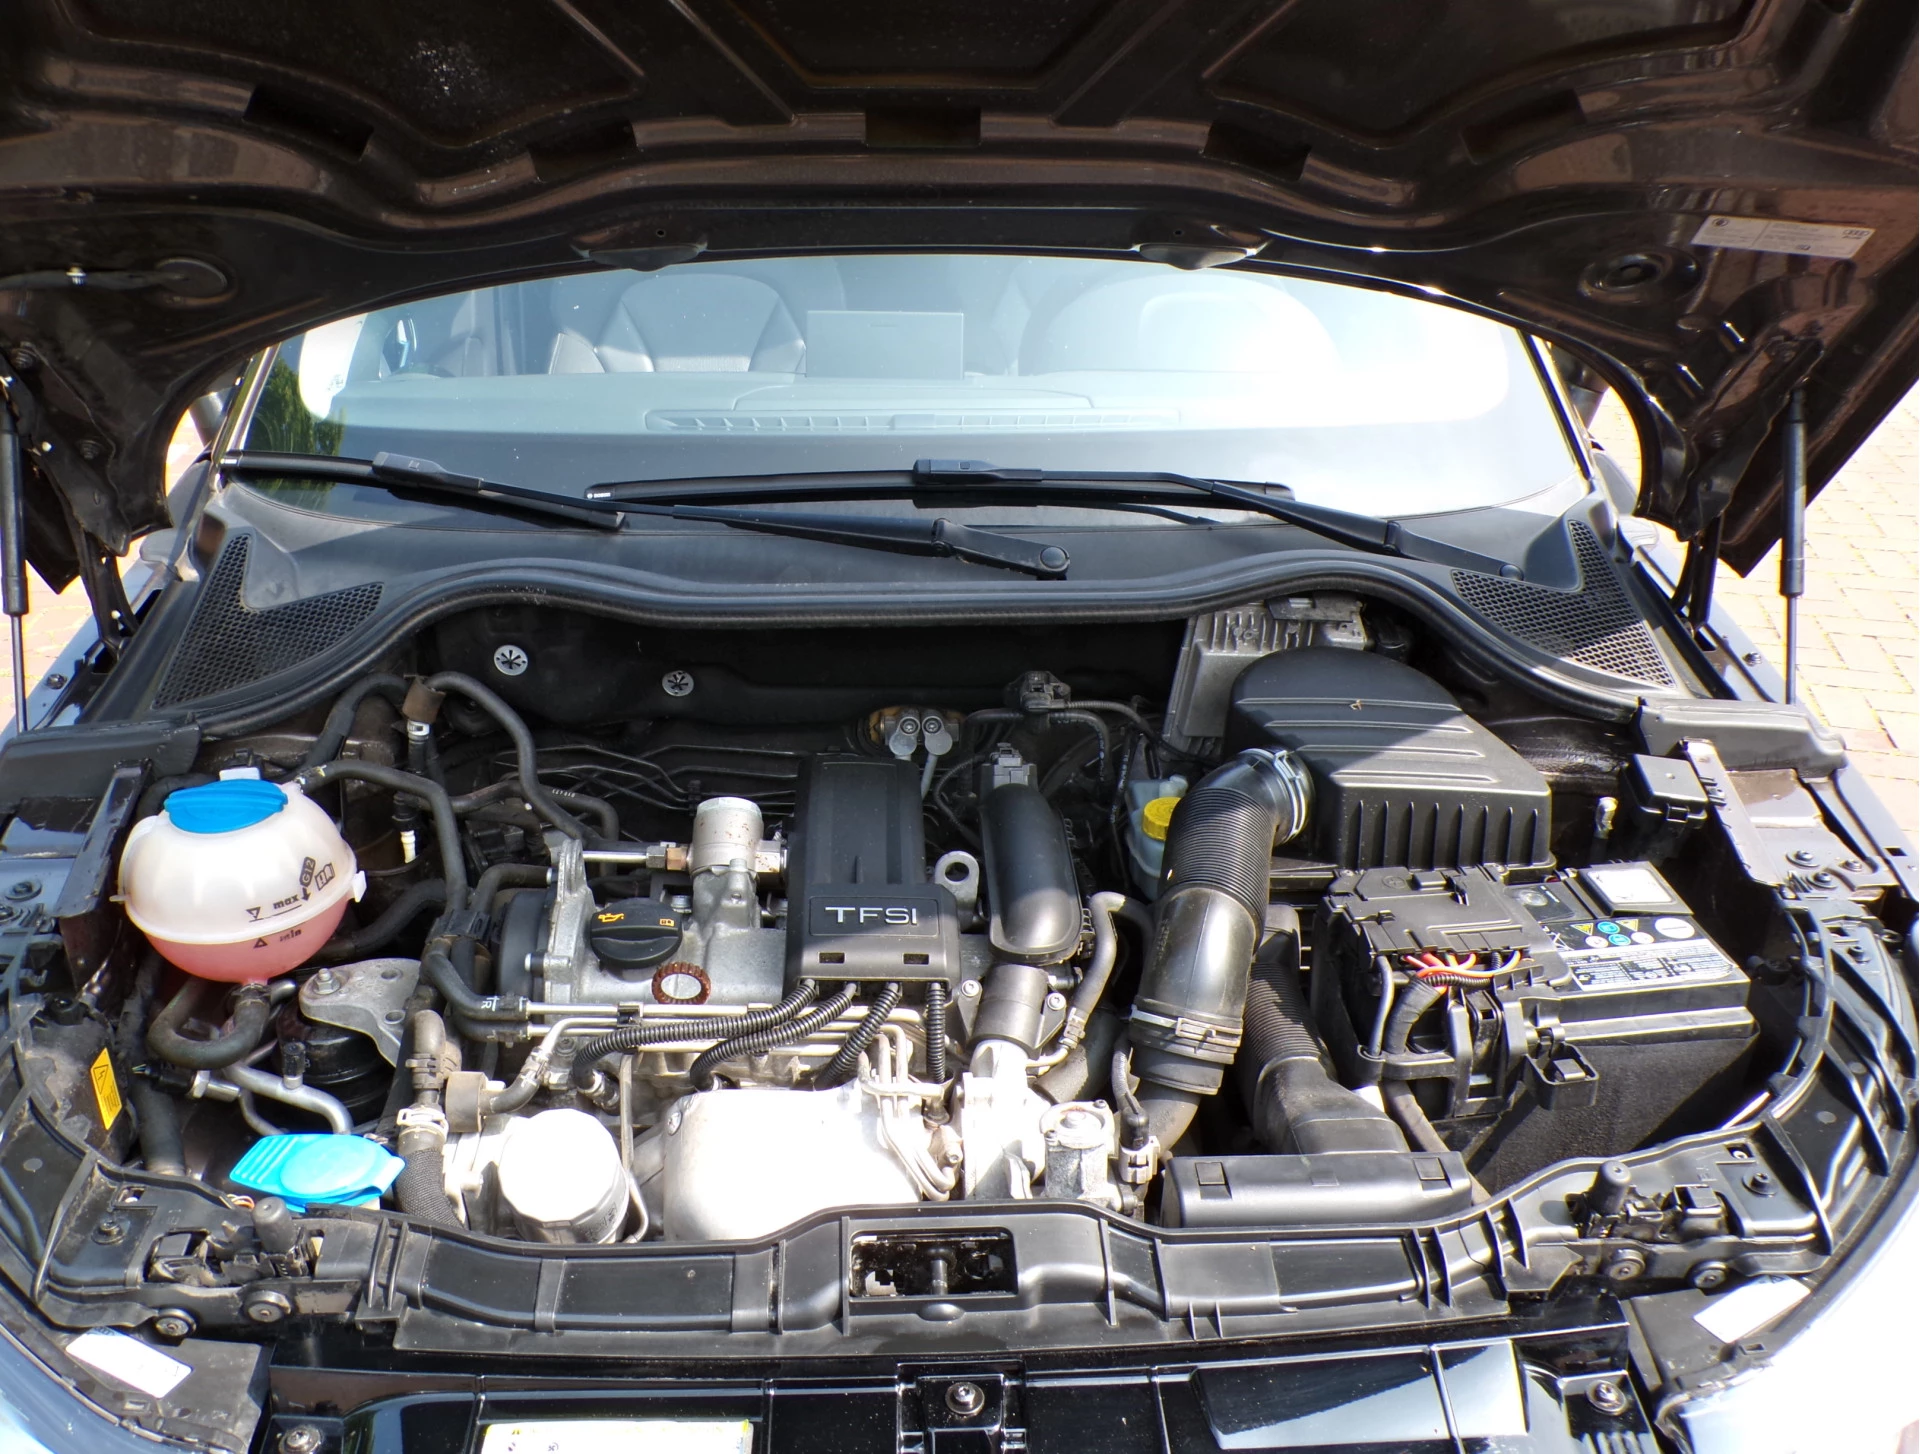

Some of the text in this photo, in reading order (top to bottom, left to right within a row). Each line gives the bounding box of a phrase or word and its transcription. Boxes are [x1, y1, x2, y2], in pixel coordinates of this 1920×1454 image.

[302, 860, 313, 883] G12
[273, 894, 299, 909] max
[825, 907, 917, 925] TFSI
